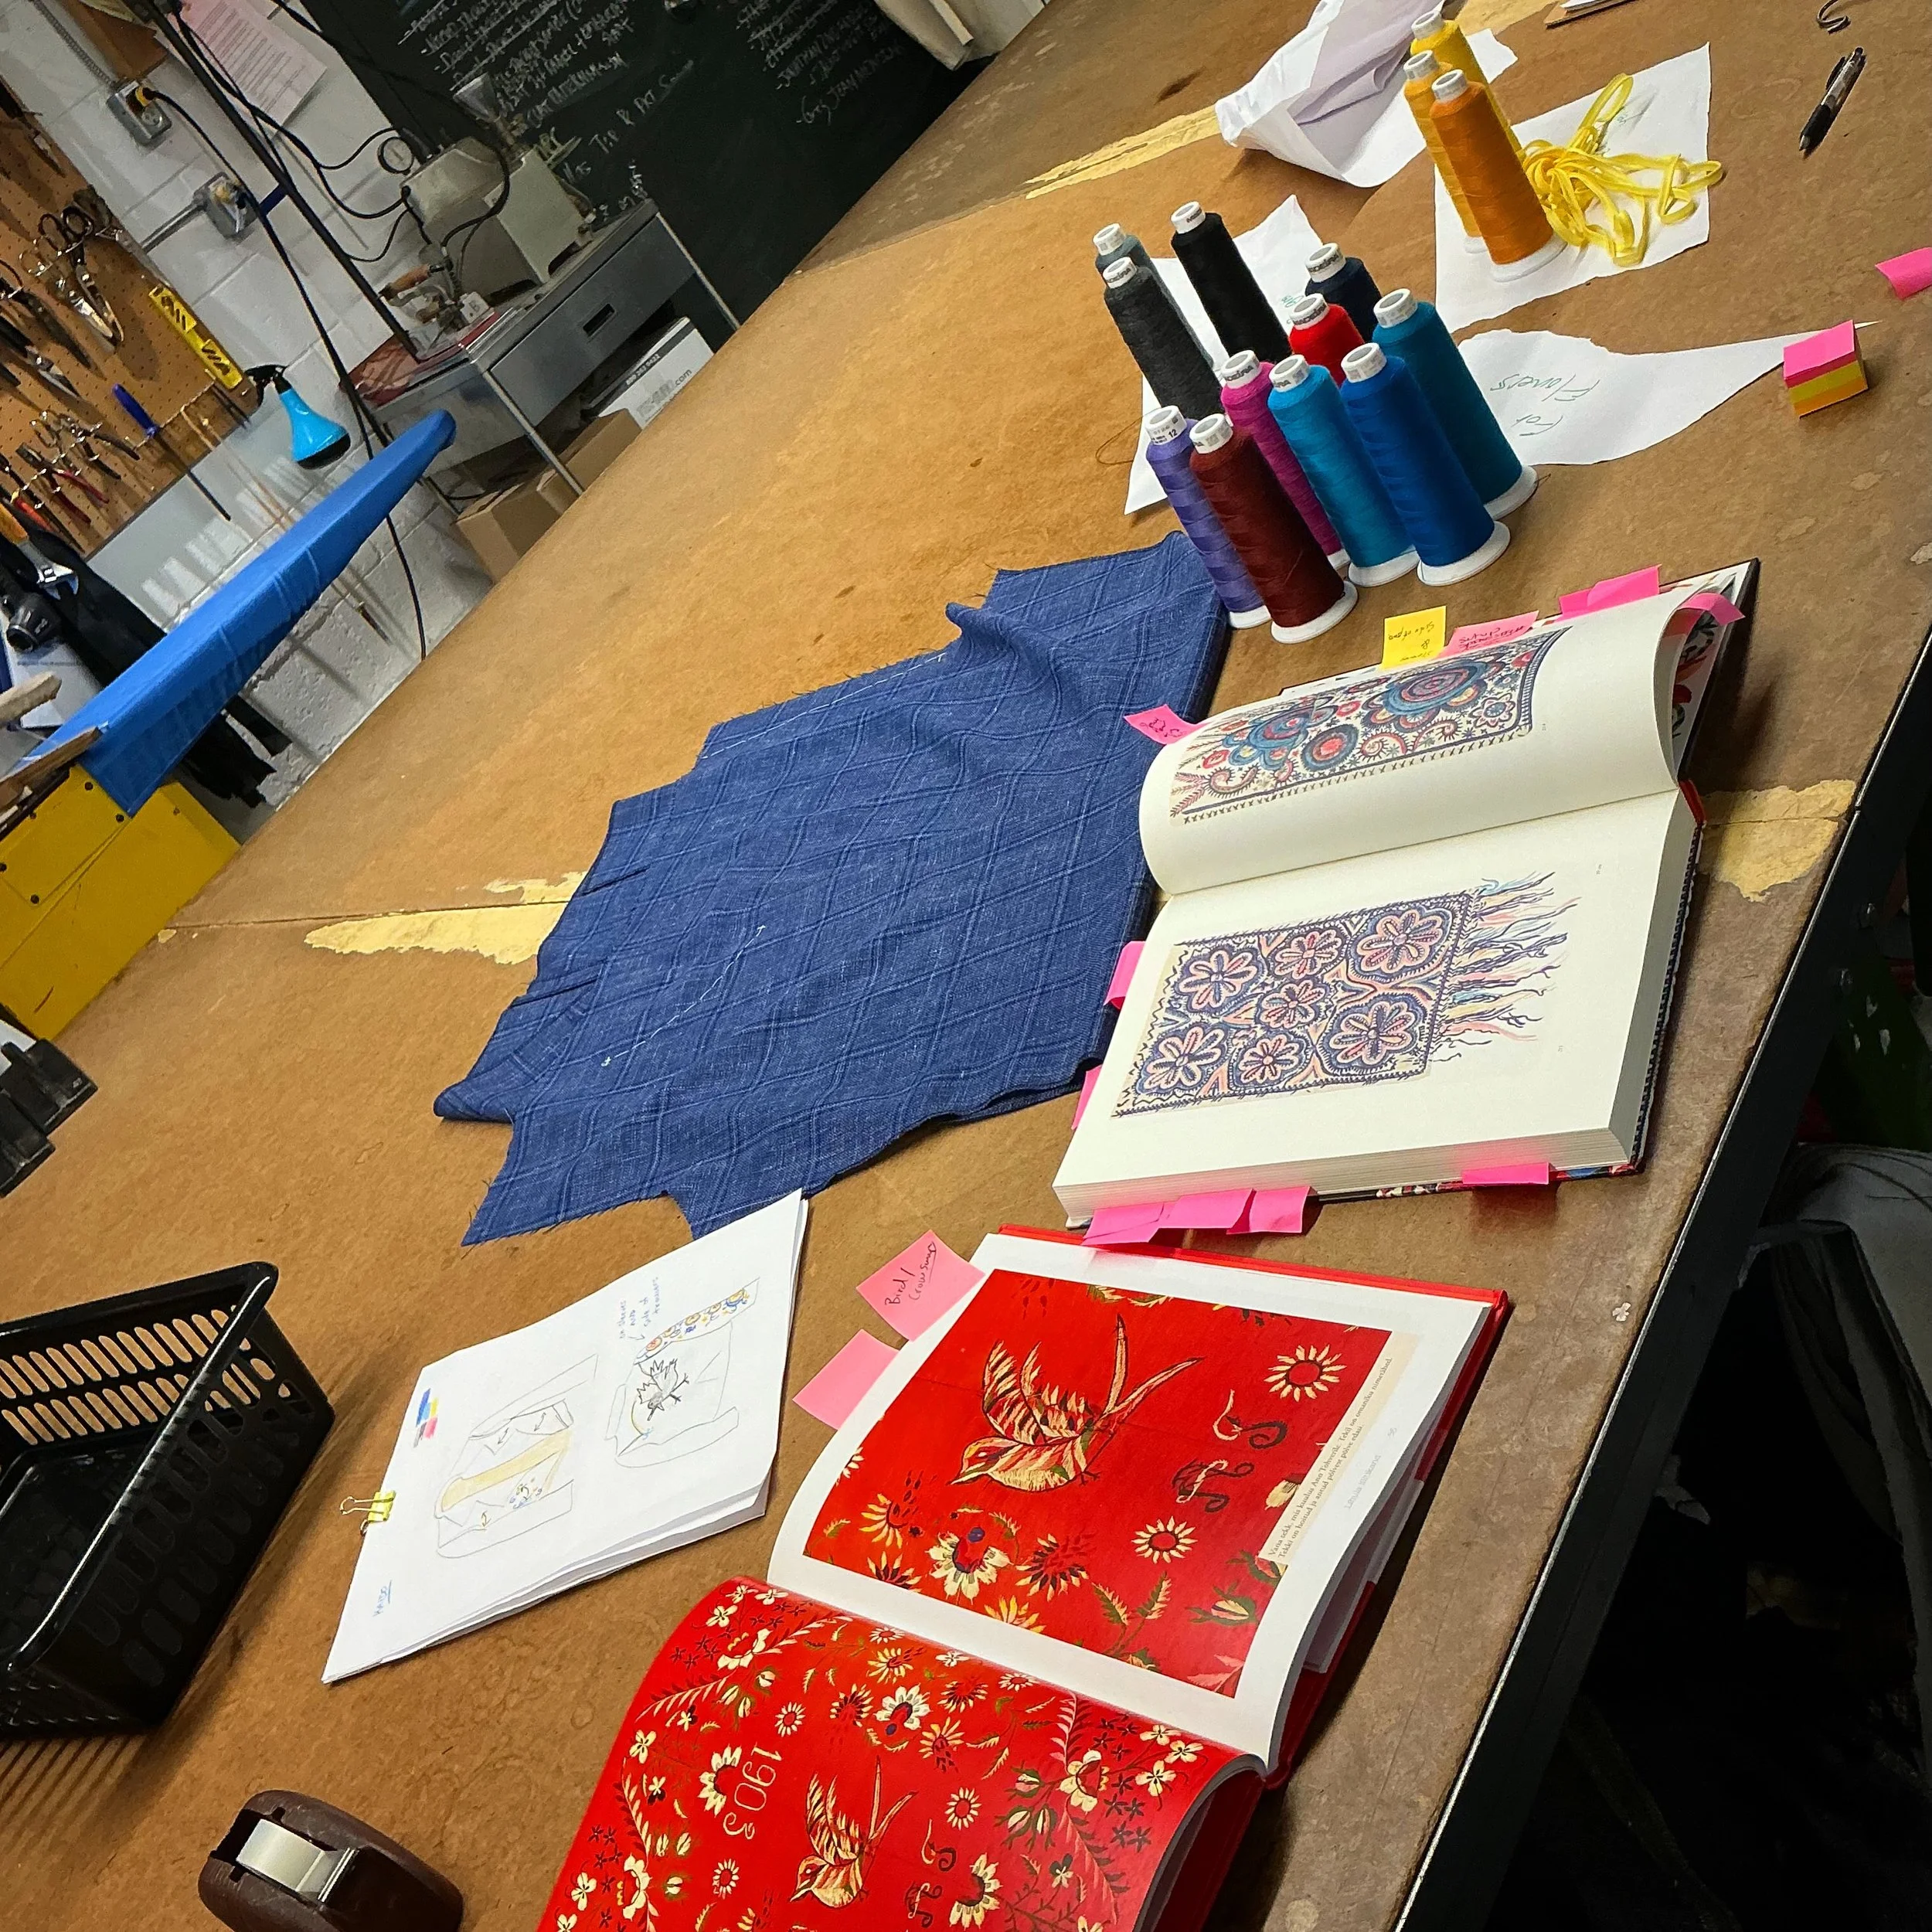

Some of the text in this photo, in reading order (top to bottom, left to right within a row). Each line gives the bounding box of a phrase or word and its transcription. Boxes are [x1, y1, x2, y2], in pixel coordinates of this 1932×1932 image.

[1168, 428, 1179, 438] 12
[1510, 413, 1564, 437] For
[1291, 1530, 1300, 1540] on
[723, 1742, 782, 1840] 1903
